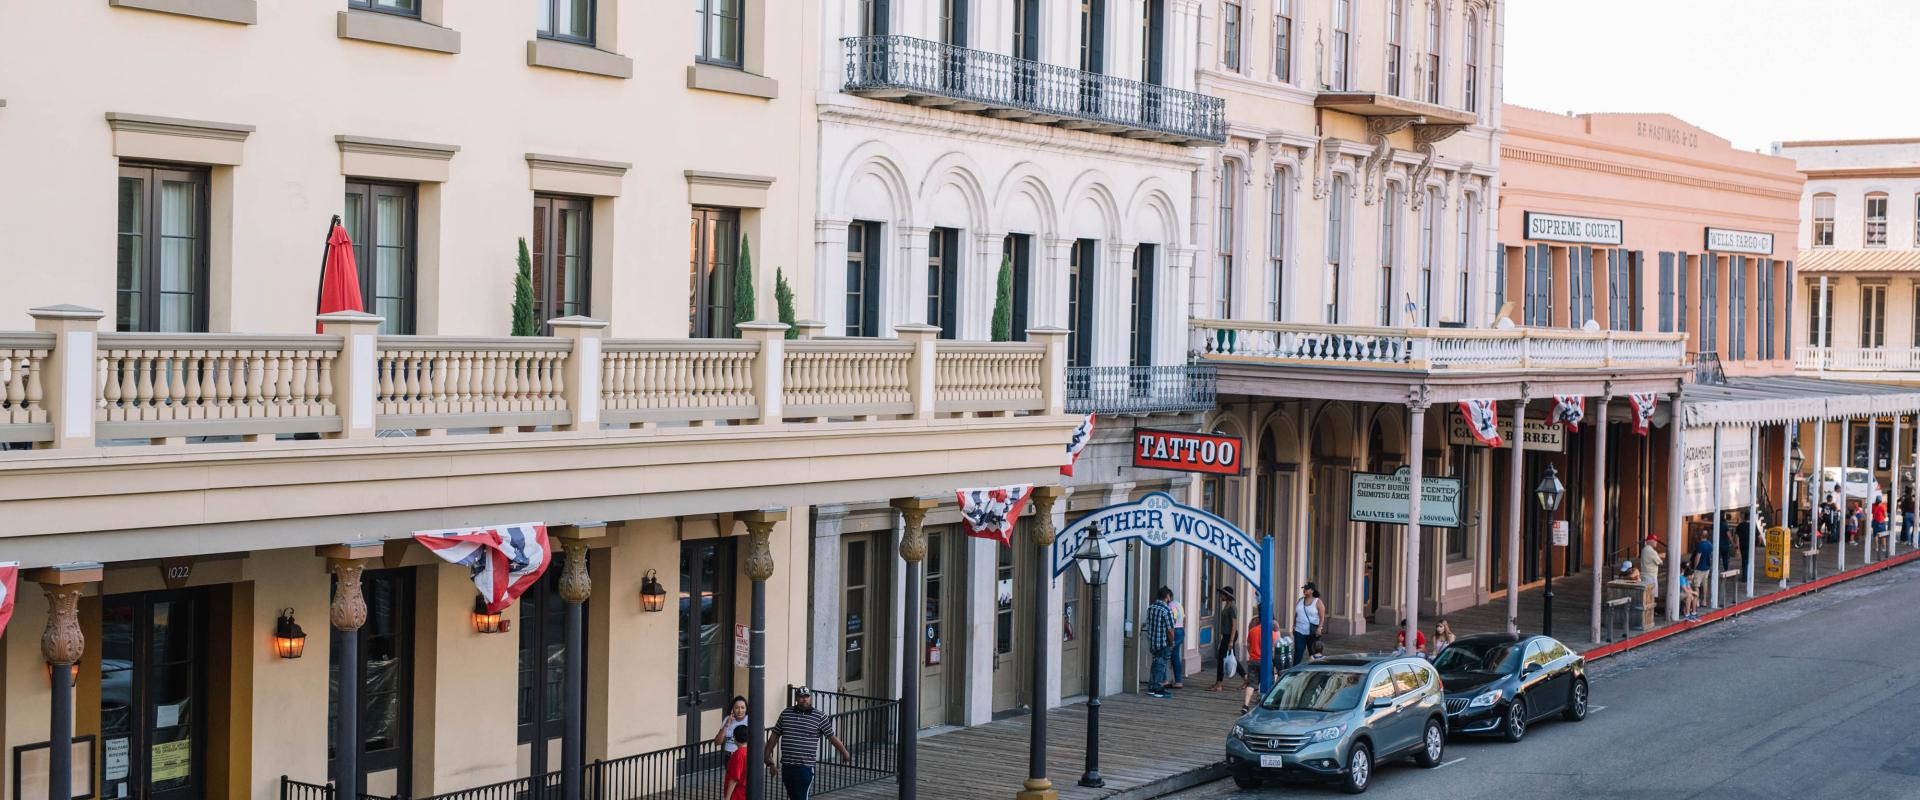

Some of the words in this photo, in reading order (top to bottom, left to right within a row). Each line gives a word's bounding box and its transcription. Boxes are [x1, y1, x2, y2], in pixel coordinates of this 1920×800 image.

[1532, 218, 1581, 236] SUPREME
[1736, 234, 1758, 249] FARGO
[1505, 430, 1560, 444] BRREL
[1139, 435, 1234, 466] TATTOO
[1357, 482, 1386, 490] FOREST
[1426, 486, 1456, 495] CENTER
[1147, 499, 1169, 510] OLD
[1423, 514, 1455, 523] SOUVENIRS
[1061, 509, 1164, 560] LETHER
[1171, 511, 1257, 572] WORKS
[1147, 531, 1168, 542] SAC
[168, 566, 189, 579] 1022
